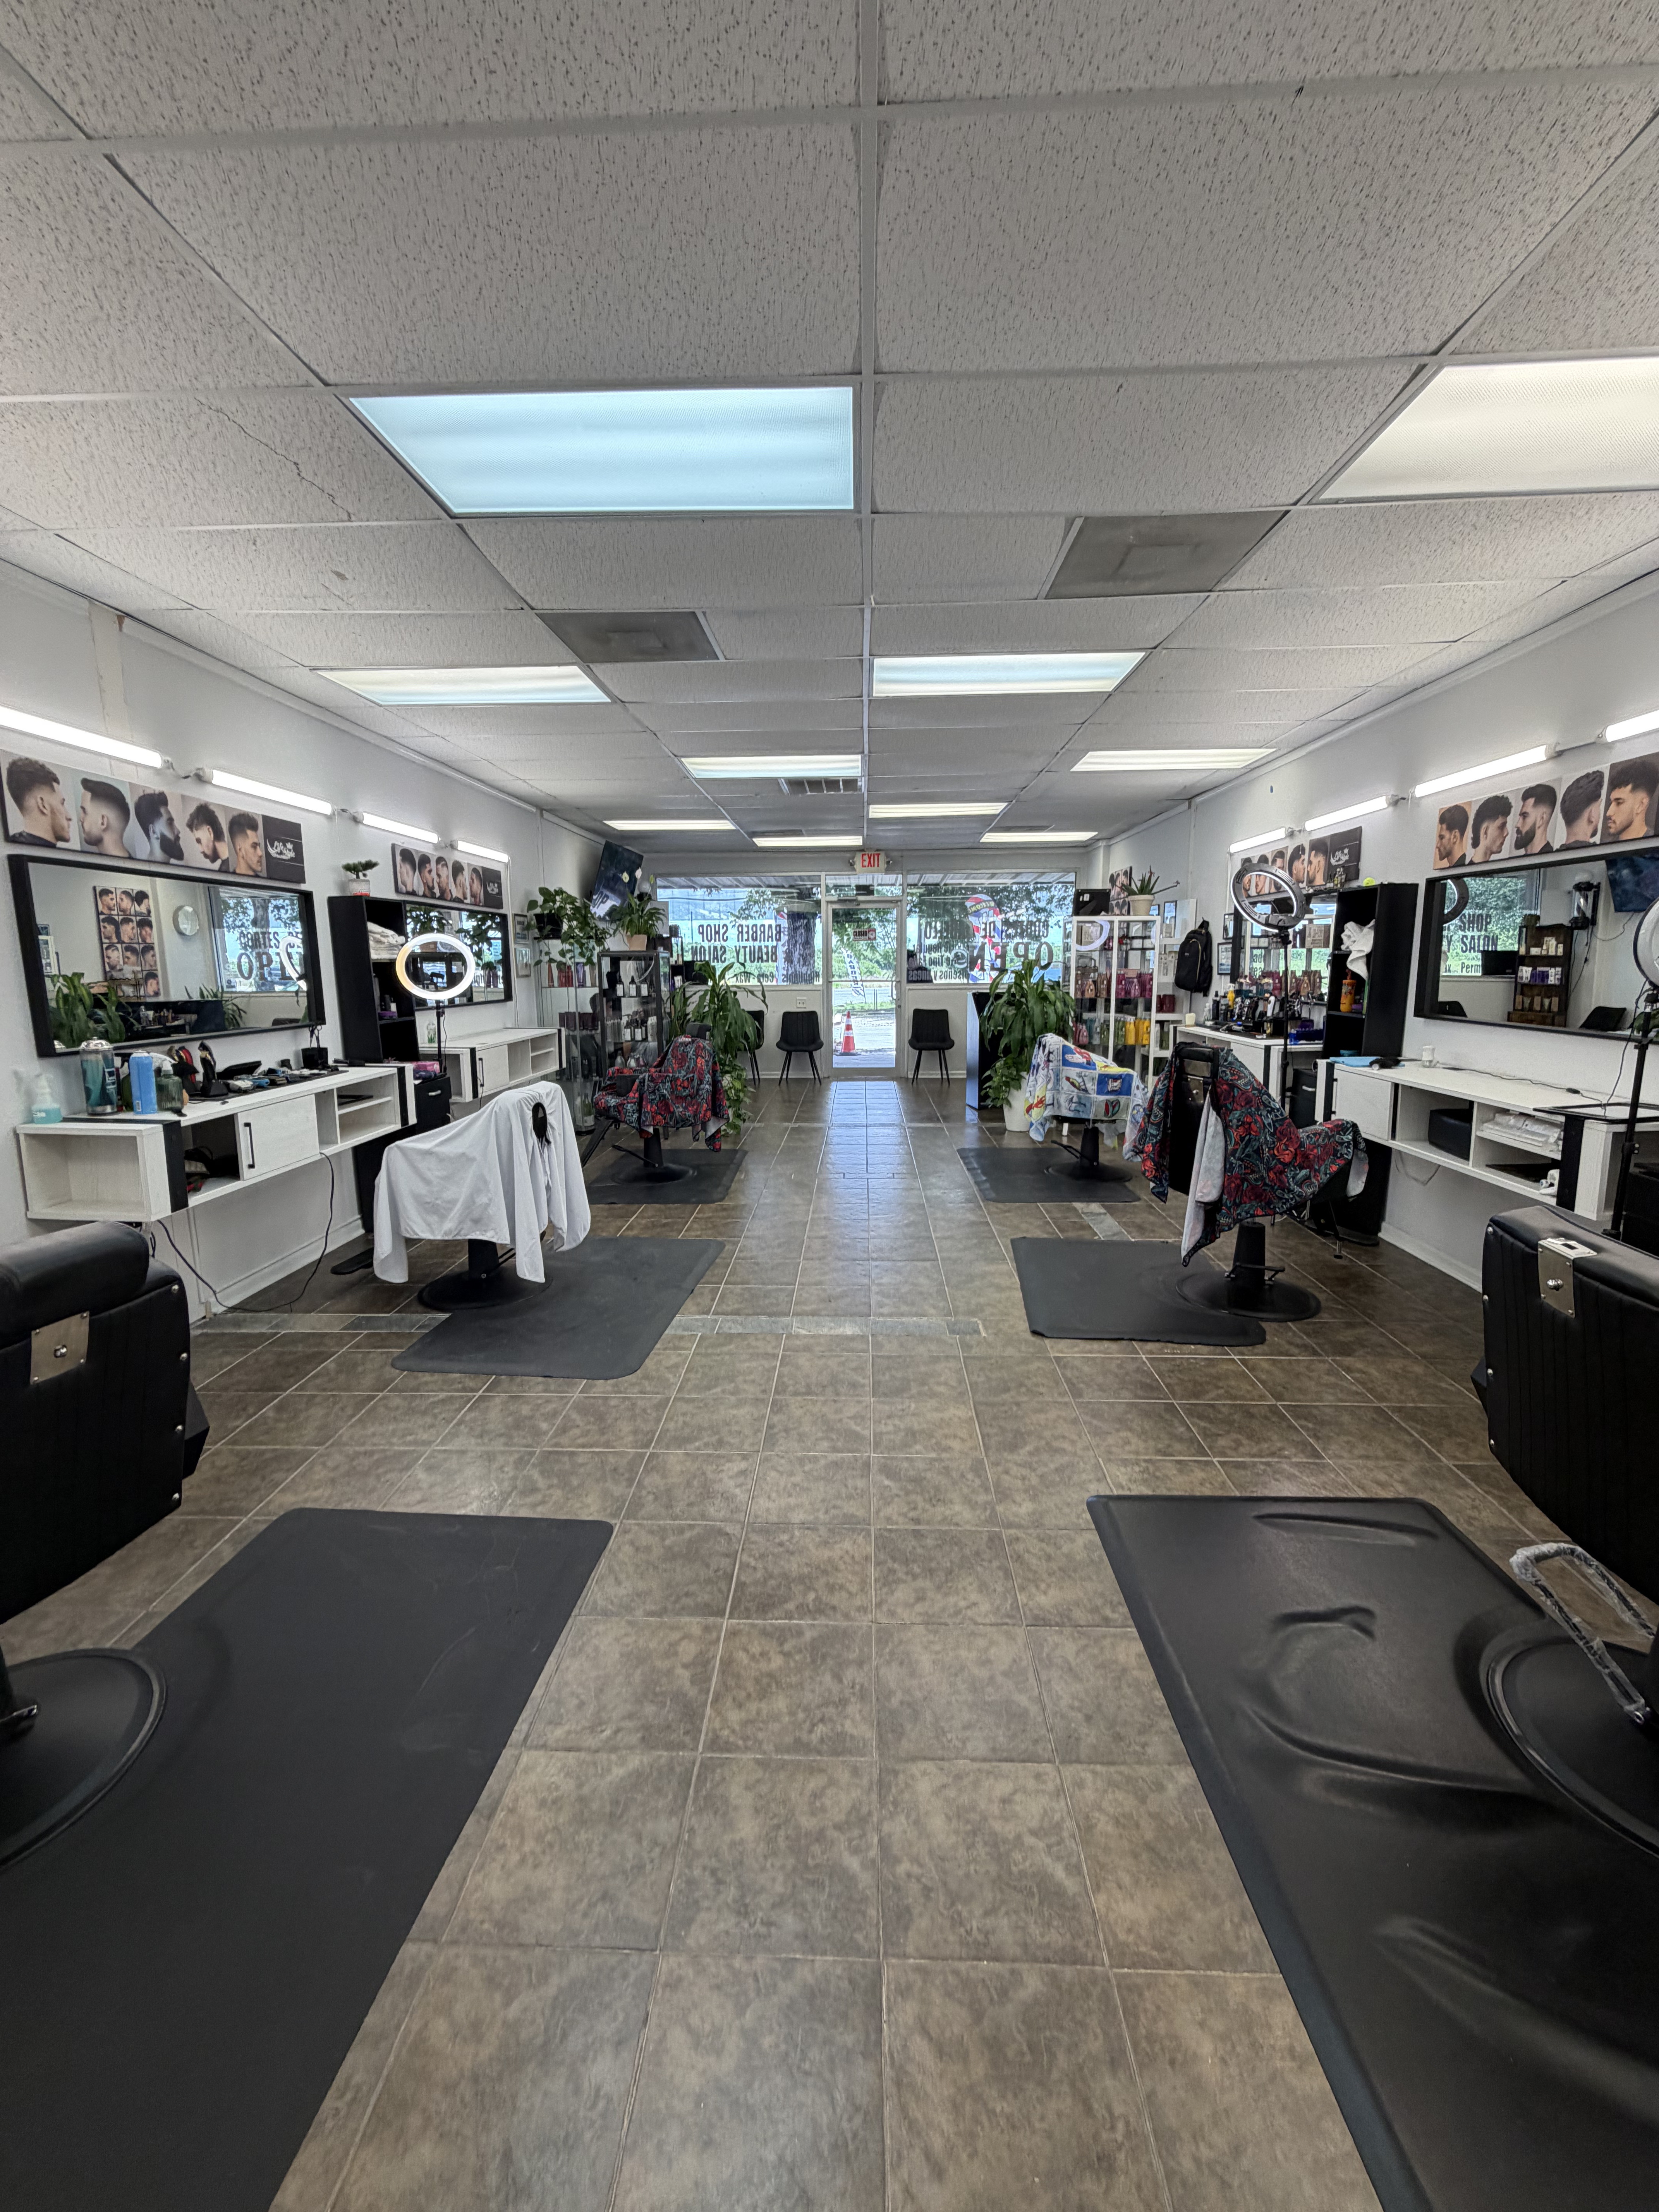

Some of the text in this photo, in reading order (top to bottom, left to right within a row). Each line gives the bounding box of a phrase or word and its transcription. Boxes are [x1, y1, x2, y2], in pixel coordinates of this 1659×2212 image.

[862, 853, 880, 867] EXIT
[1459, 913, 1491, 932] SHOP
[1461, 935, 1498, 953] SALON
[1461, 962, 1481, 974] Perm
